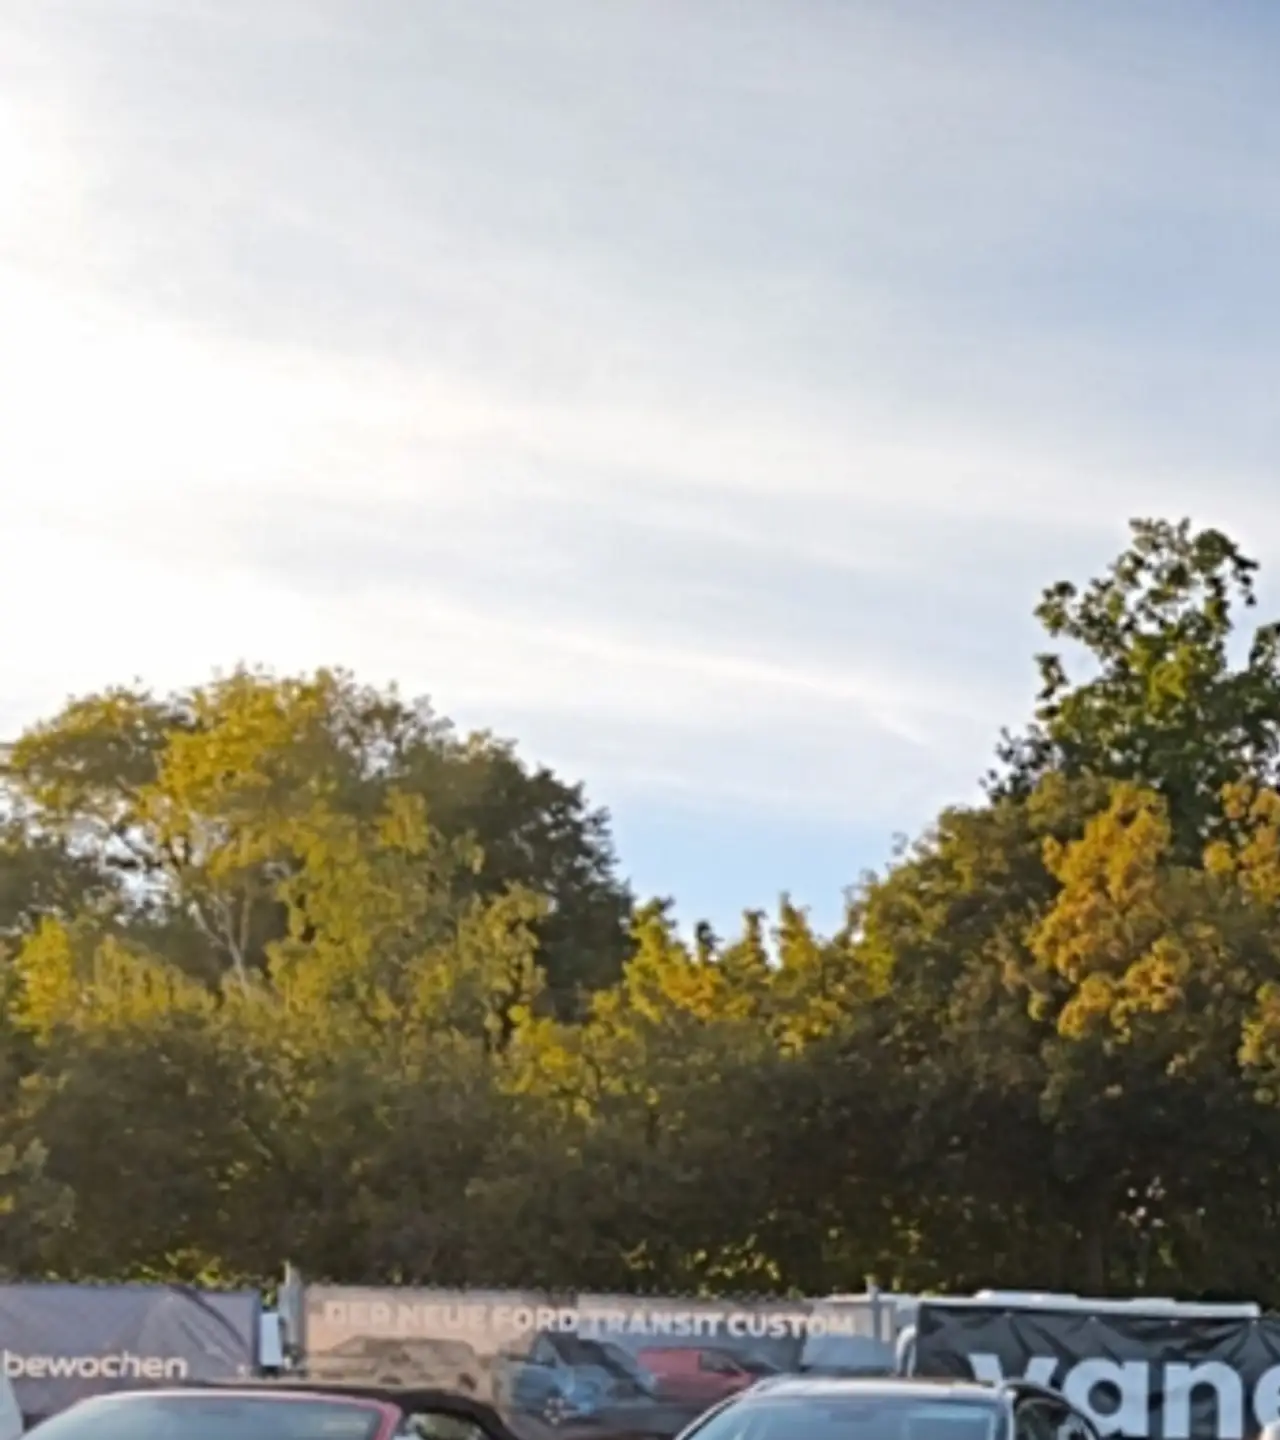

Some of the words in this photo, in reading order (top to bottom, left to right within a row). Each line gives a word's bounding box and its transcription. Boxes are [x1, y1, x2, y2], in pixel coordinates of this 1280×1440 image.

[491, 1304, 581, 1333] FORD
[584, 1307, 723, 1337] TRANSIT
[727, 1310, 856, 1339] CUSTOM
[3, 1349, 189, 1379] bewochen
